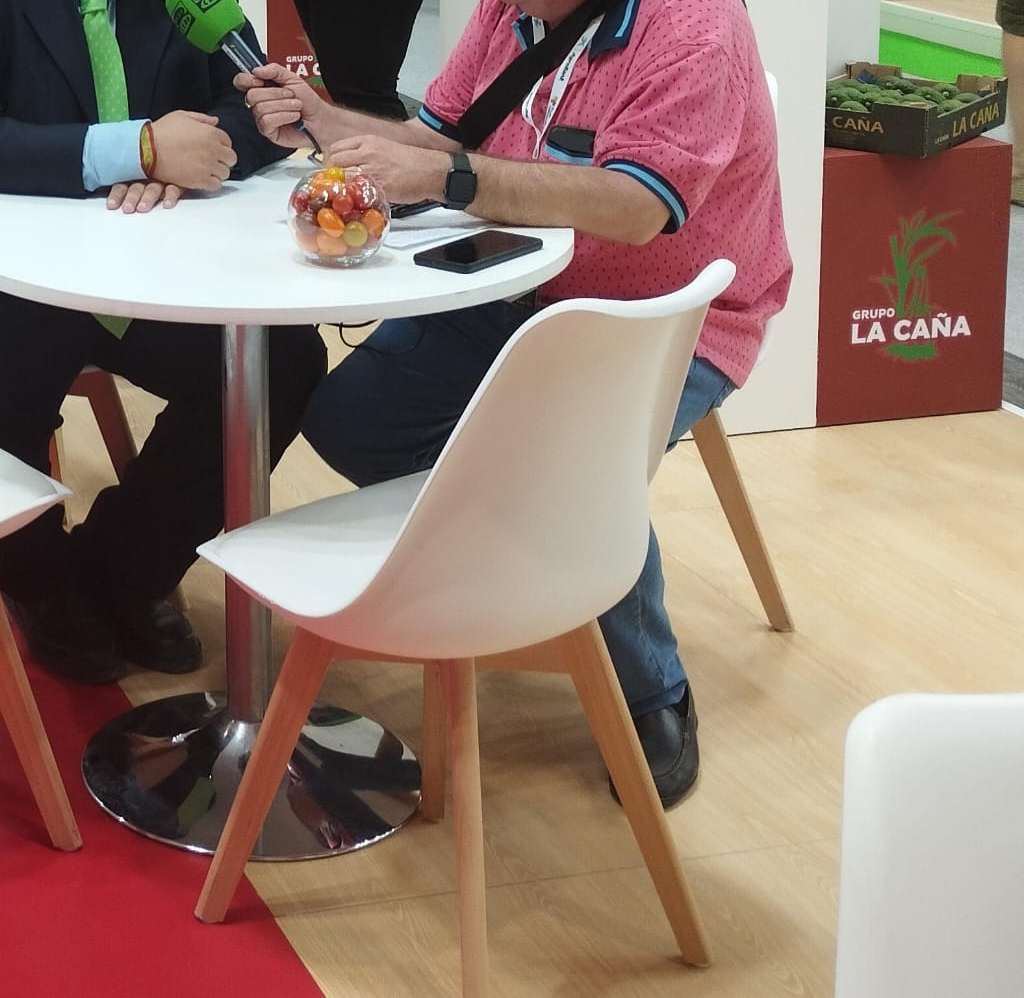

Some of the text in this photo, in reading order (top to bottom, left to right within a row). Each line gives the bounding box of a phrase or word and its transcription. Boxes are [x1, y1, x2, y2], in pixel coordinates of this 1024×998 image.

[286, 55, 314, 63] GRUPO
[832, 116, 885, 134] CAÑA
[952, 119, 967, 138] LA
[852, 307, 896, 320] GRUPO
[852, 312, 972, 345] LA CAÑA
